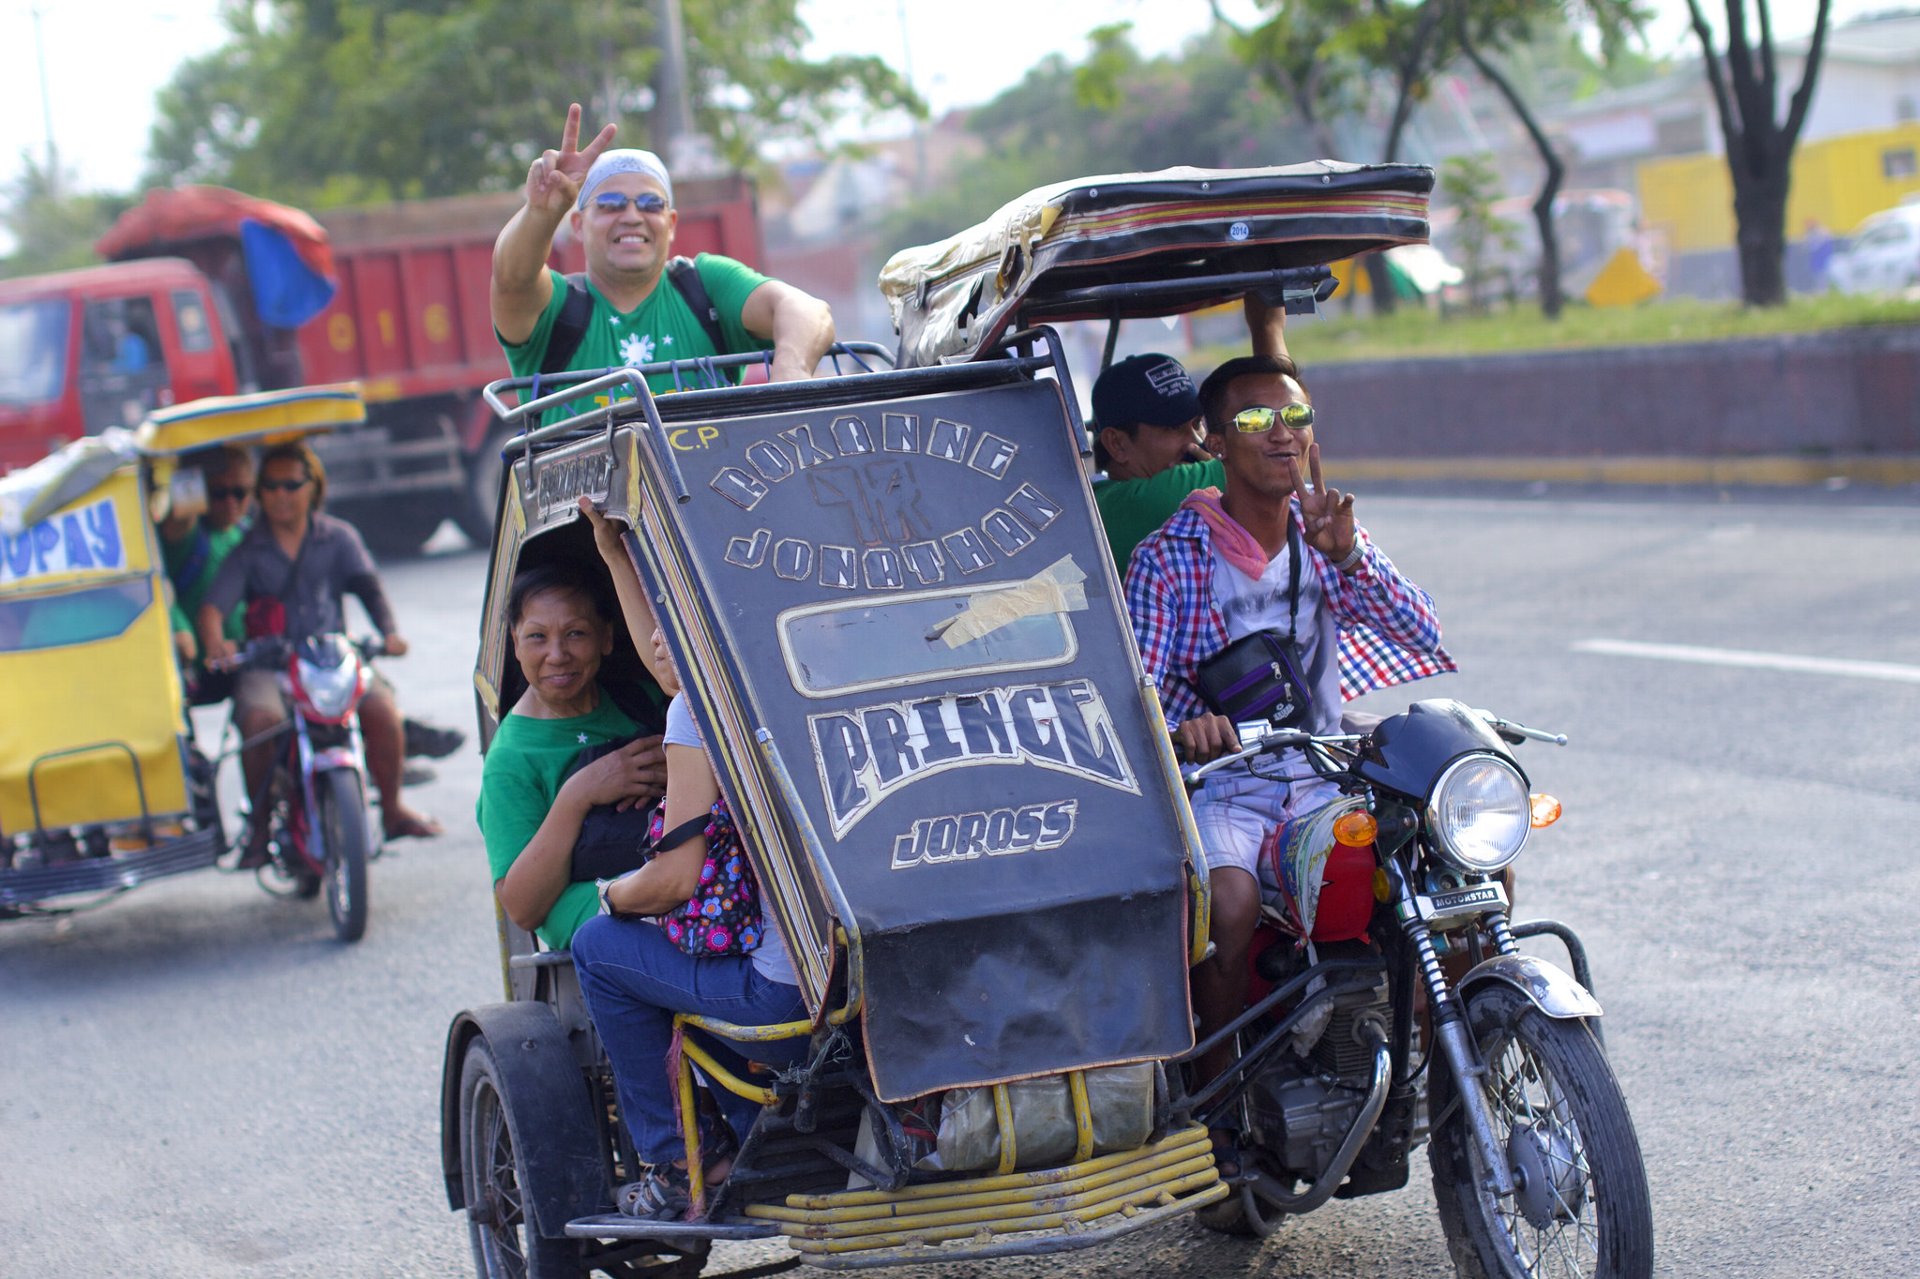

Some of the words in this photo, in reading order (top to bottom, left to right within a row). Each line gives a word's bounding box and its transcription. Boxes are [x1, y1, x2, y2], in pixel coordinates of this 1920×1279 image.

[1232, 227, 1247, 236] 2014
[709, 411, 1019, 511] ROXANNE
[723, 482, 1063, 590] JONATHAN
[891, 799, 1078, 870] JOROSS
[1436, 890, 1495, 907] MOTORSTAR
